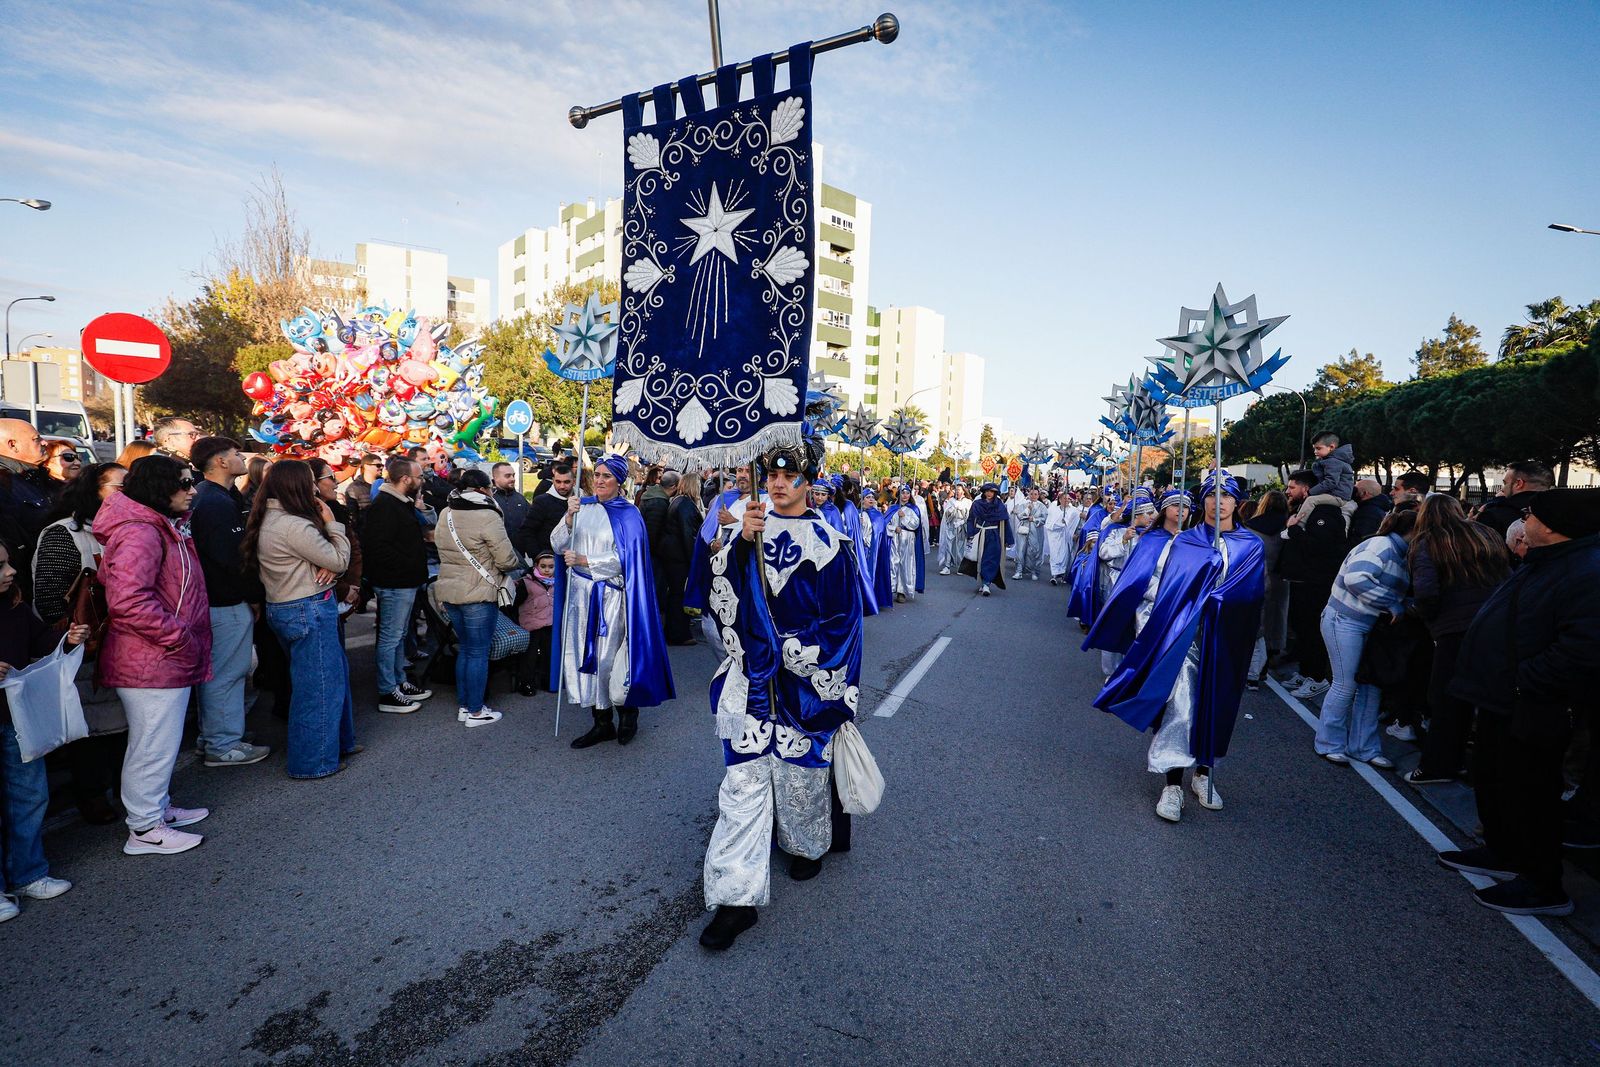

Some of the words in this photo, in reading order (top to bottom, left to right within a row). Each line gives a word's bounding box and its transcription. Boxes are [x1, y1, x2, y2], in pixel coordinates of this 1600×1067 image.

[562, 368, 603, 381] ESTRELLA
[1188, 383, 1245, 399] ESTRELLA
[469, 557, 482, 570] TOUS
